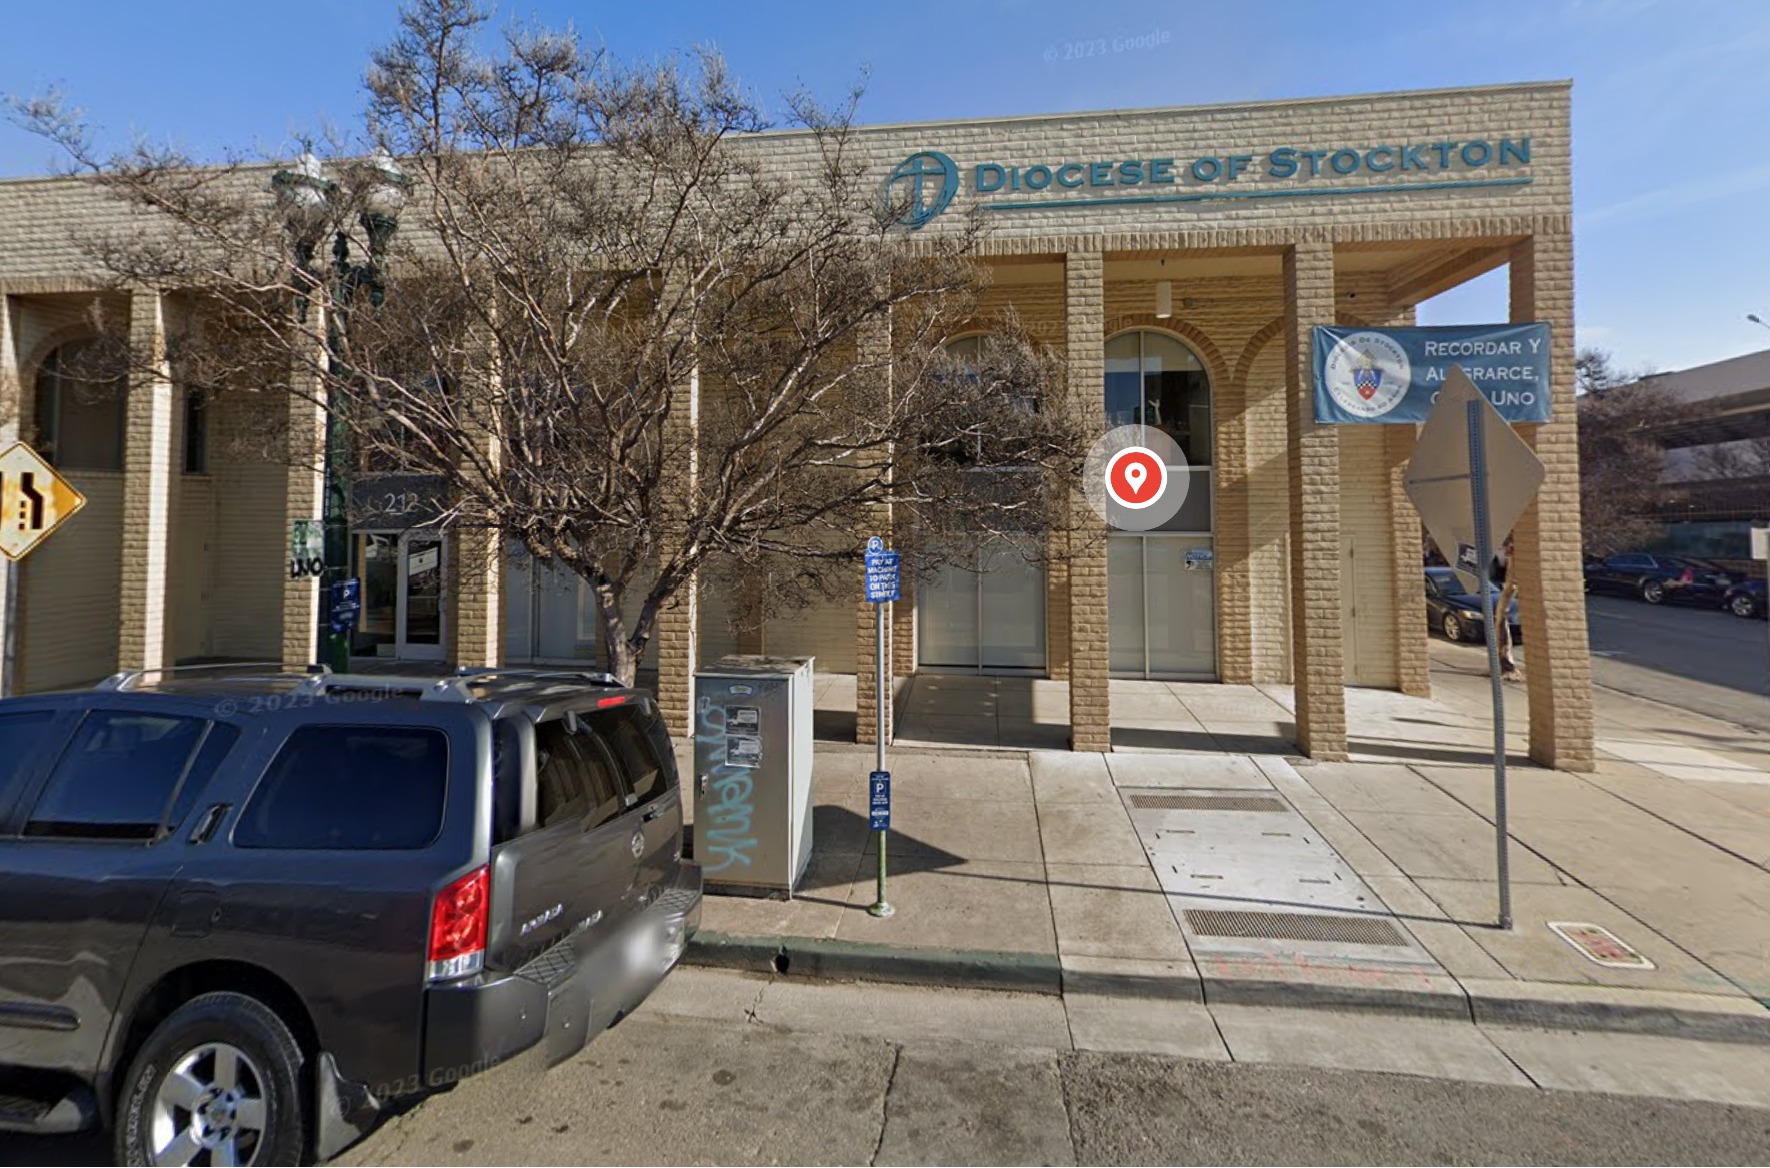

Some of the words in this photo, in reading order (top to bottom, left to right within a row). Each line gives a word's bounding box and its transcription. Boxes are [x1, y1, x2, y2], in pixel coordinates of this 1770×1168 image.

[1424, 340, 1522, 356] RECORDAR
[1528, 338, 1541, 354] Y
[1491, 390, 1535, 406] UNO
[876, 783, 885, 793] P
